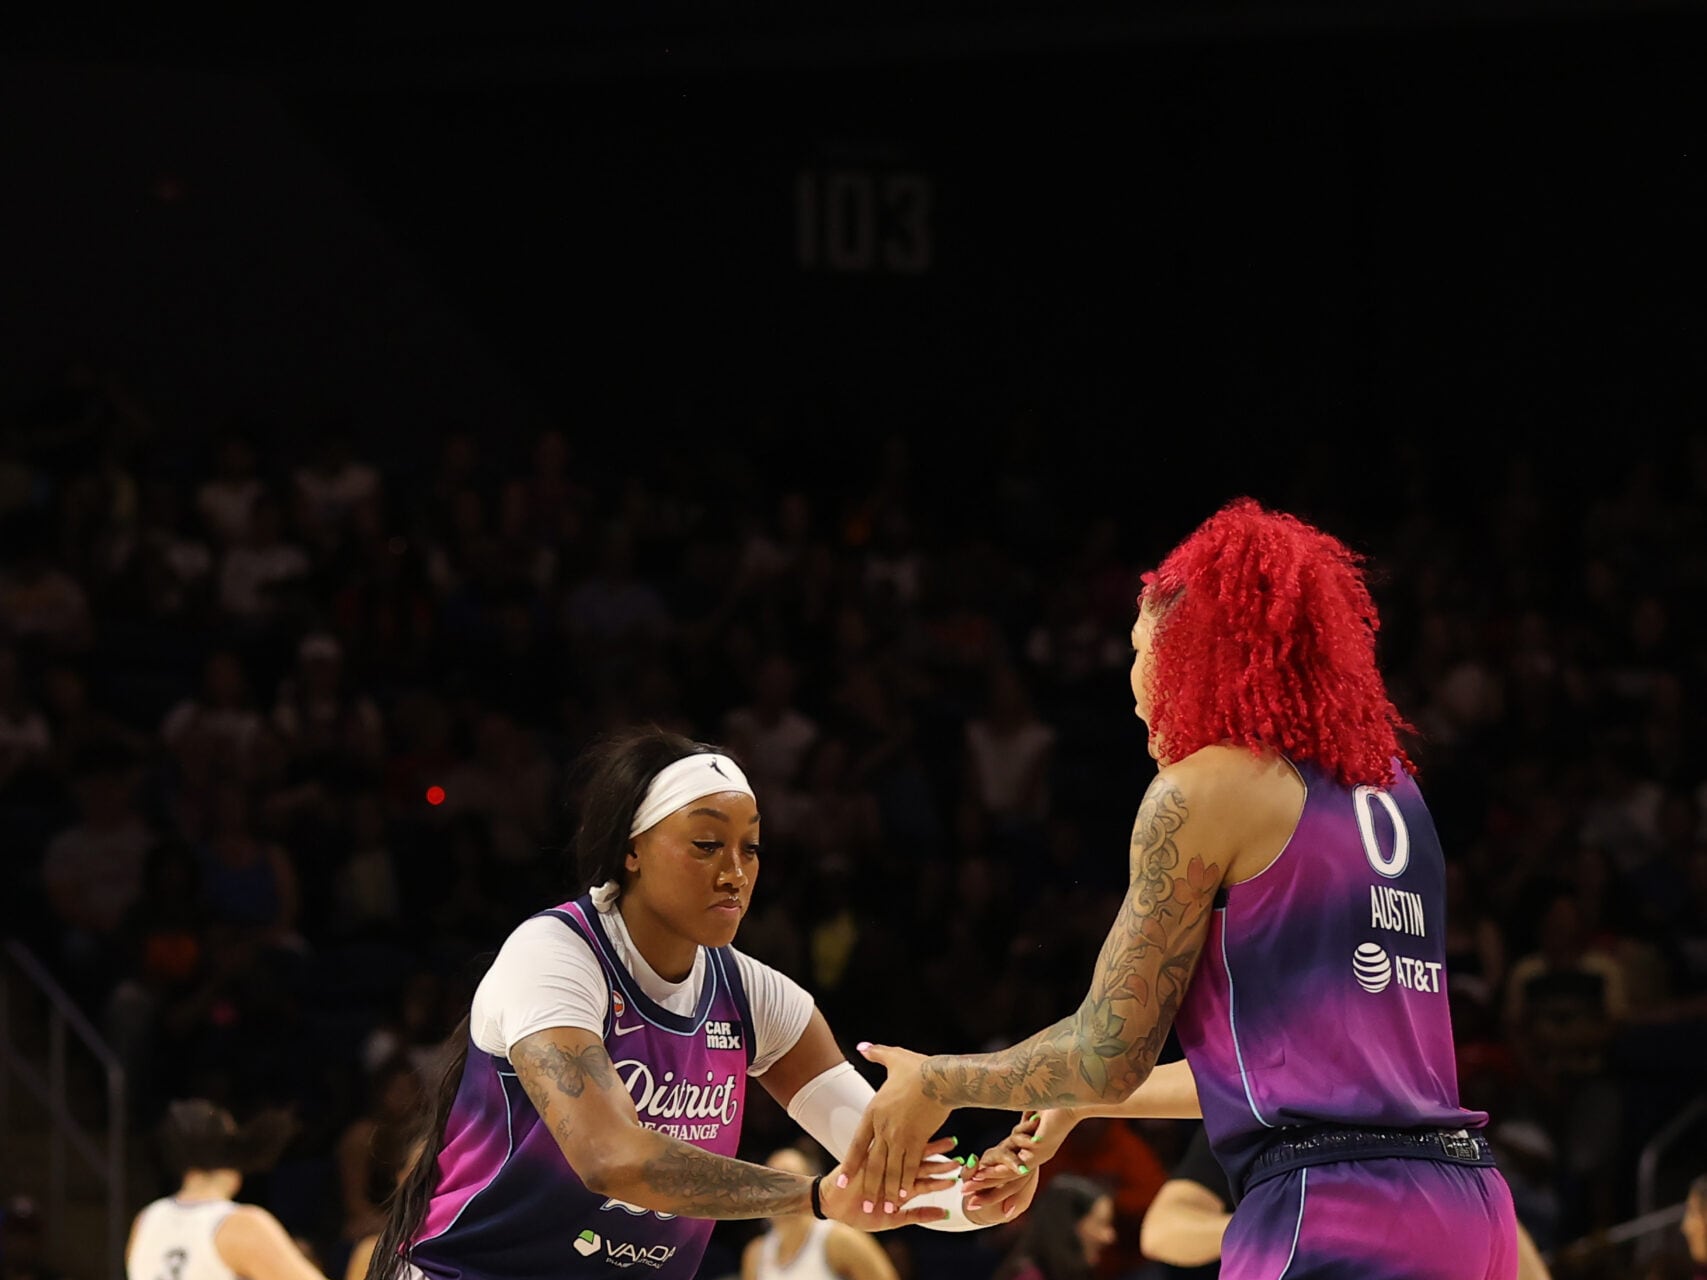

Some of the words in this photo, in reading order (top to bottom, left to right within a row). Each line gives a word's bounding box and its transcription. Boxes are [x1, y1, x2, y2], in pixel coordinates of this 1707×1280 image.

[795, 170, 935, 275] 103
[1352, 782, 1410, 879] 0
[1370, 885, 1425, 937] AUSTIN
[1395, 955, 1442, 993] AT&T
[705, 1021, 732, 1035] CAR
[706, 1034, 741, 1049] max
[614, 1060, 737, 1125] District
[657, 1124, 720, 1141] CHANGE
